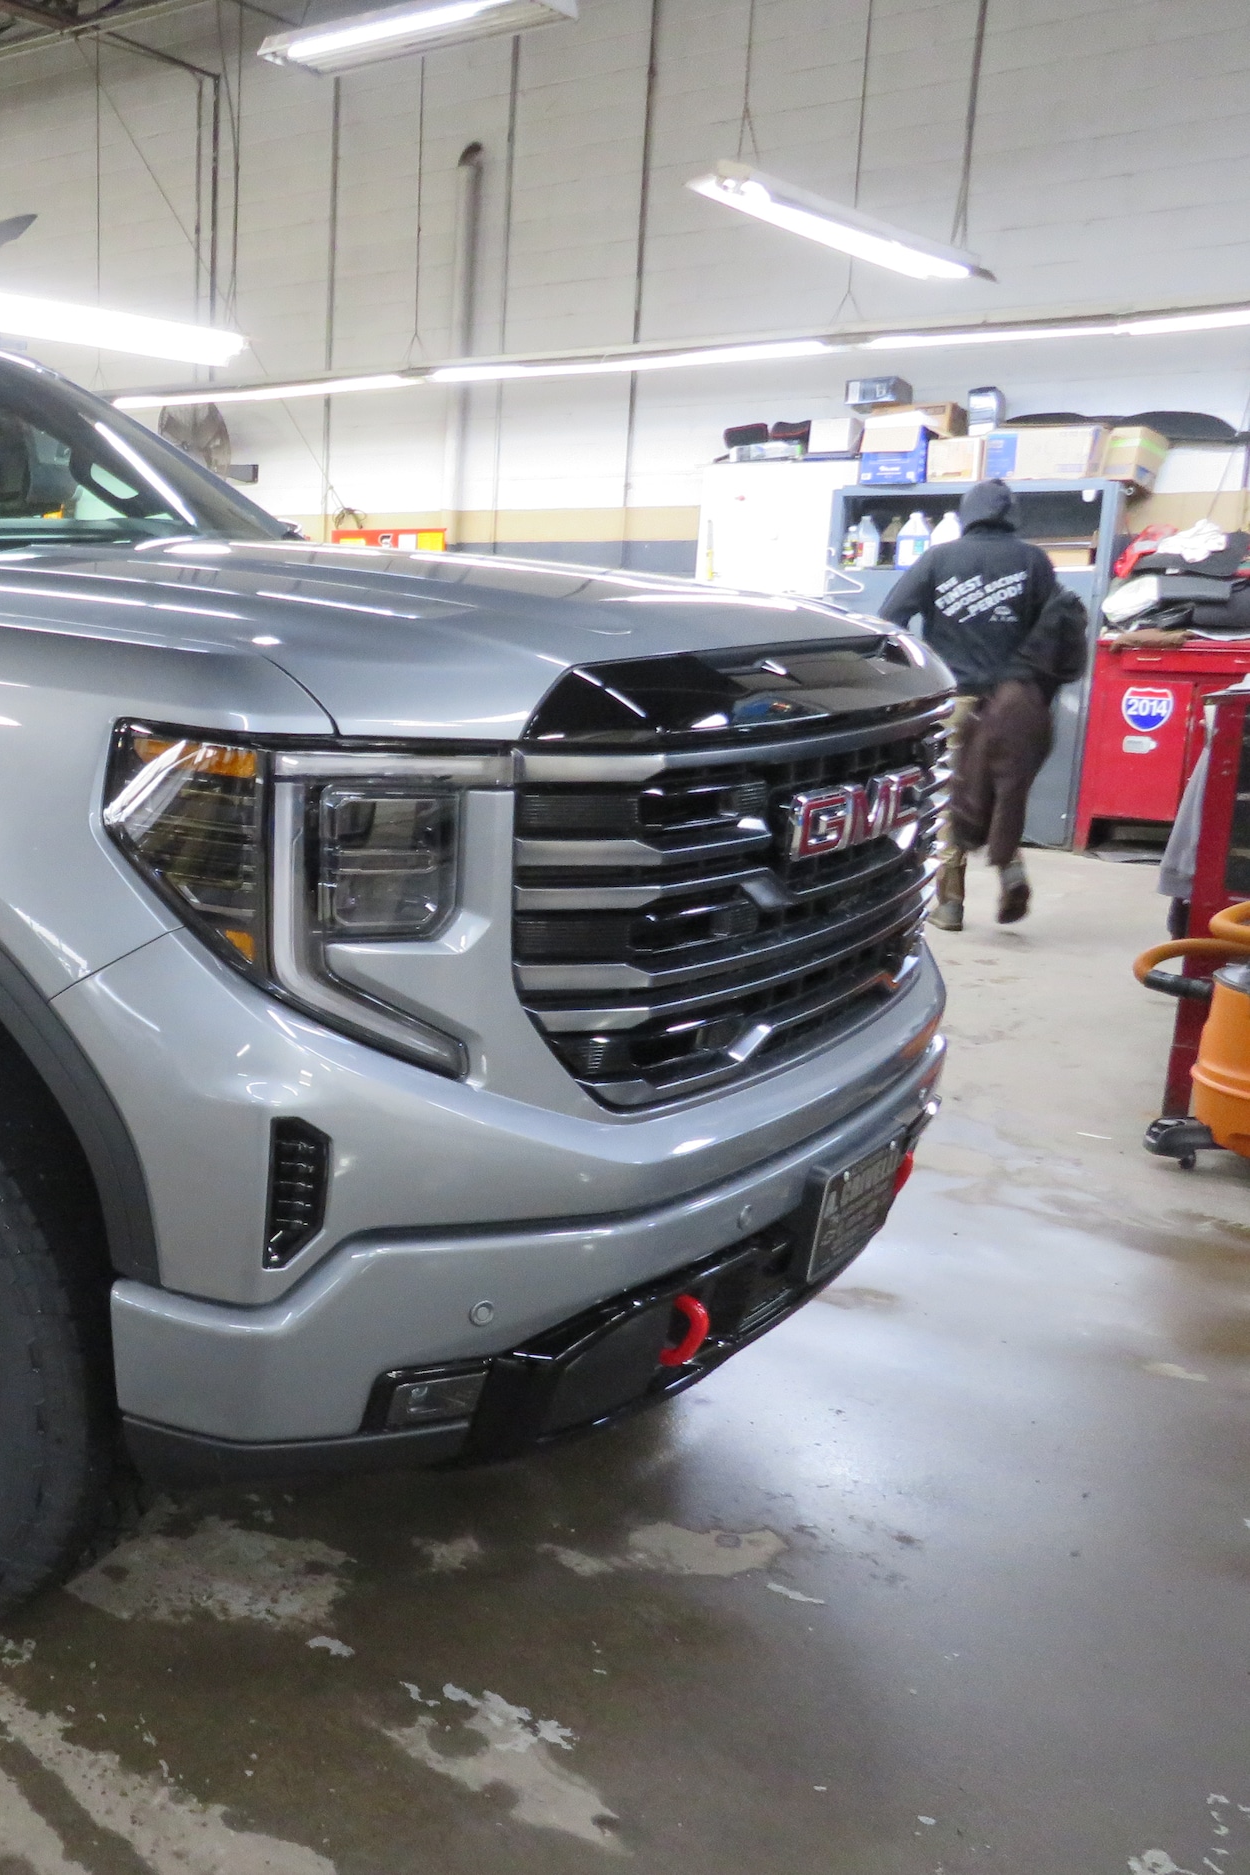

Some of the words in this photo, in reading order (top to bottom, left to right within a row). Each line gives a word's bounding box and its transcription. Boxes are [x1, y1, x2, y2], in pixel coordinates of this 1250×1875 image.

[934, 575, 983, 609] FINEST
[984, 571, 1028, 594] RACING
[1127, 699, 1168, 716] 2014
[790, 764, 923, 861] GMC
